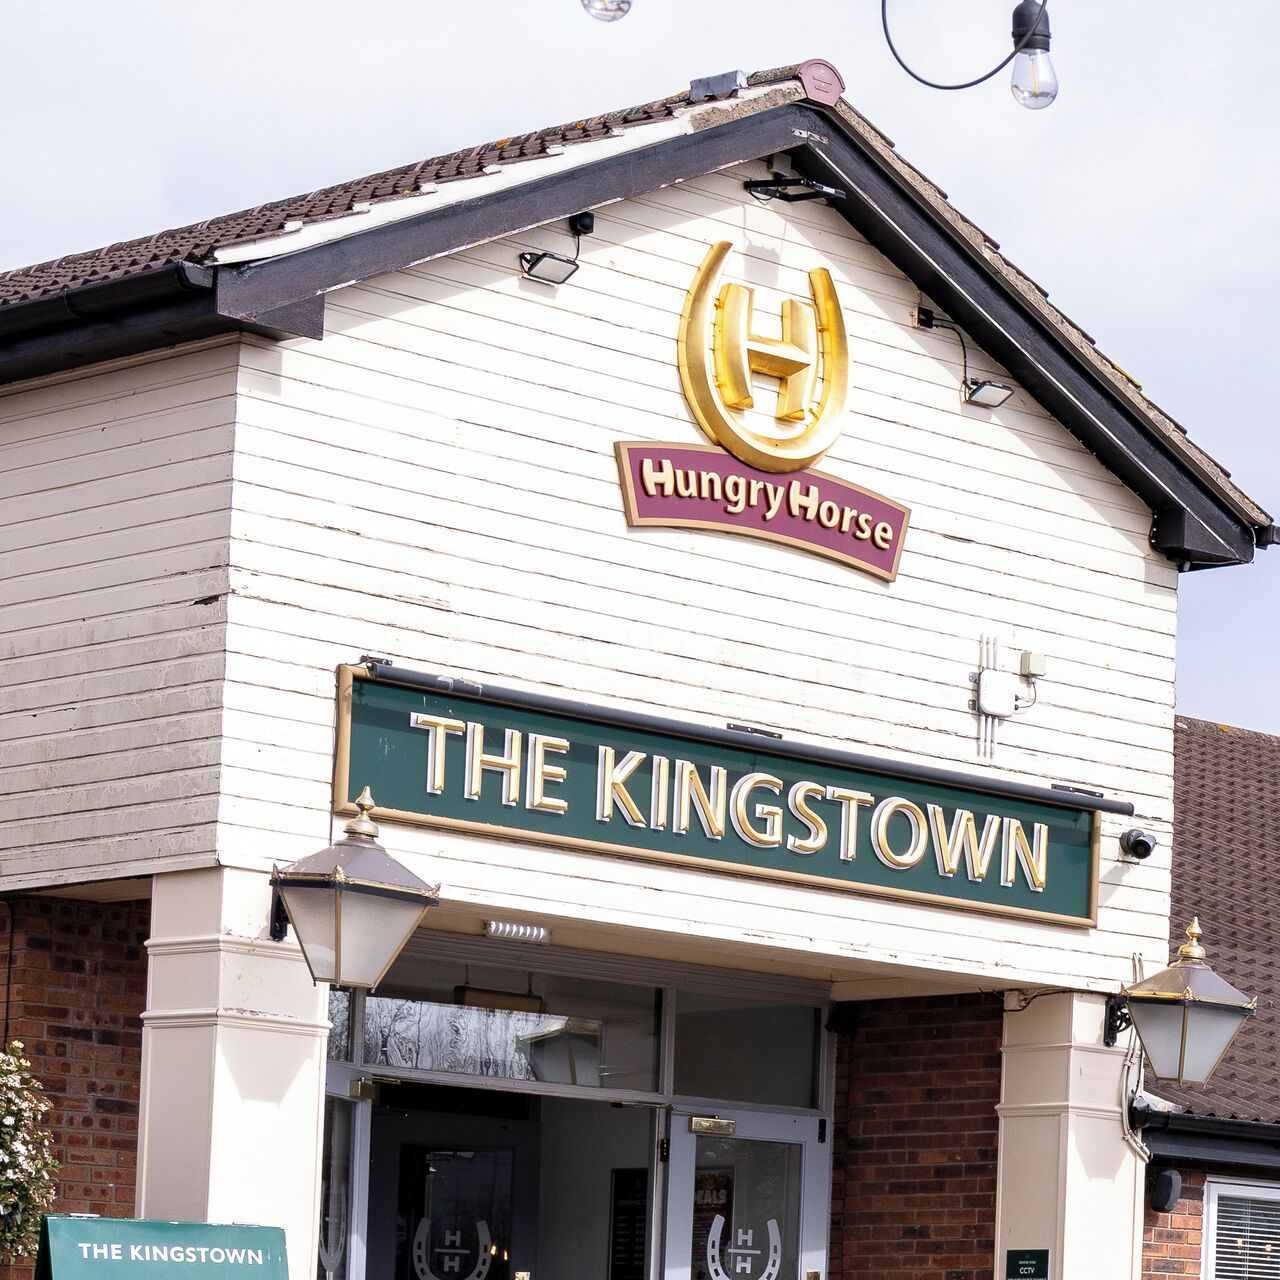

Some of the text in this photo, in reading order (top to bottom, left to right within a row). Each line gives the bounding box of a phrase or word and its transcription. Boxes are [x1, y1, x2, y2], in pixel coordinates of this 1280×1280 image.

[409, 711, 1049, 893] THE KINGSTOWN
[78, 1242, 263, 1265] THE KINGSTOWN
[1019, 1266, 1035, 1274] CCTV
